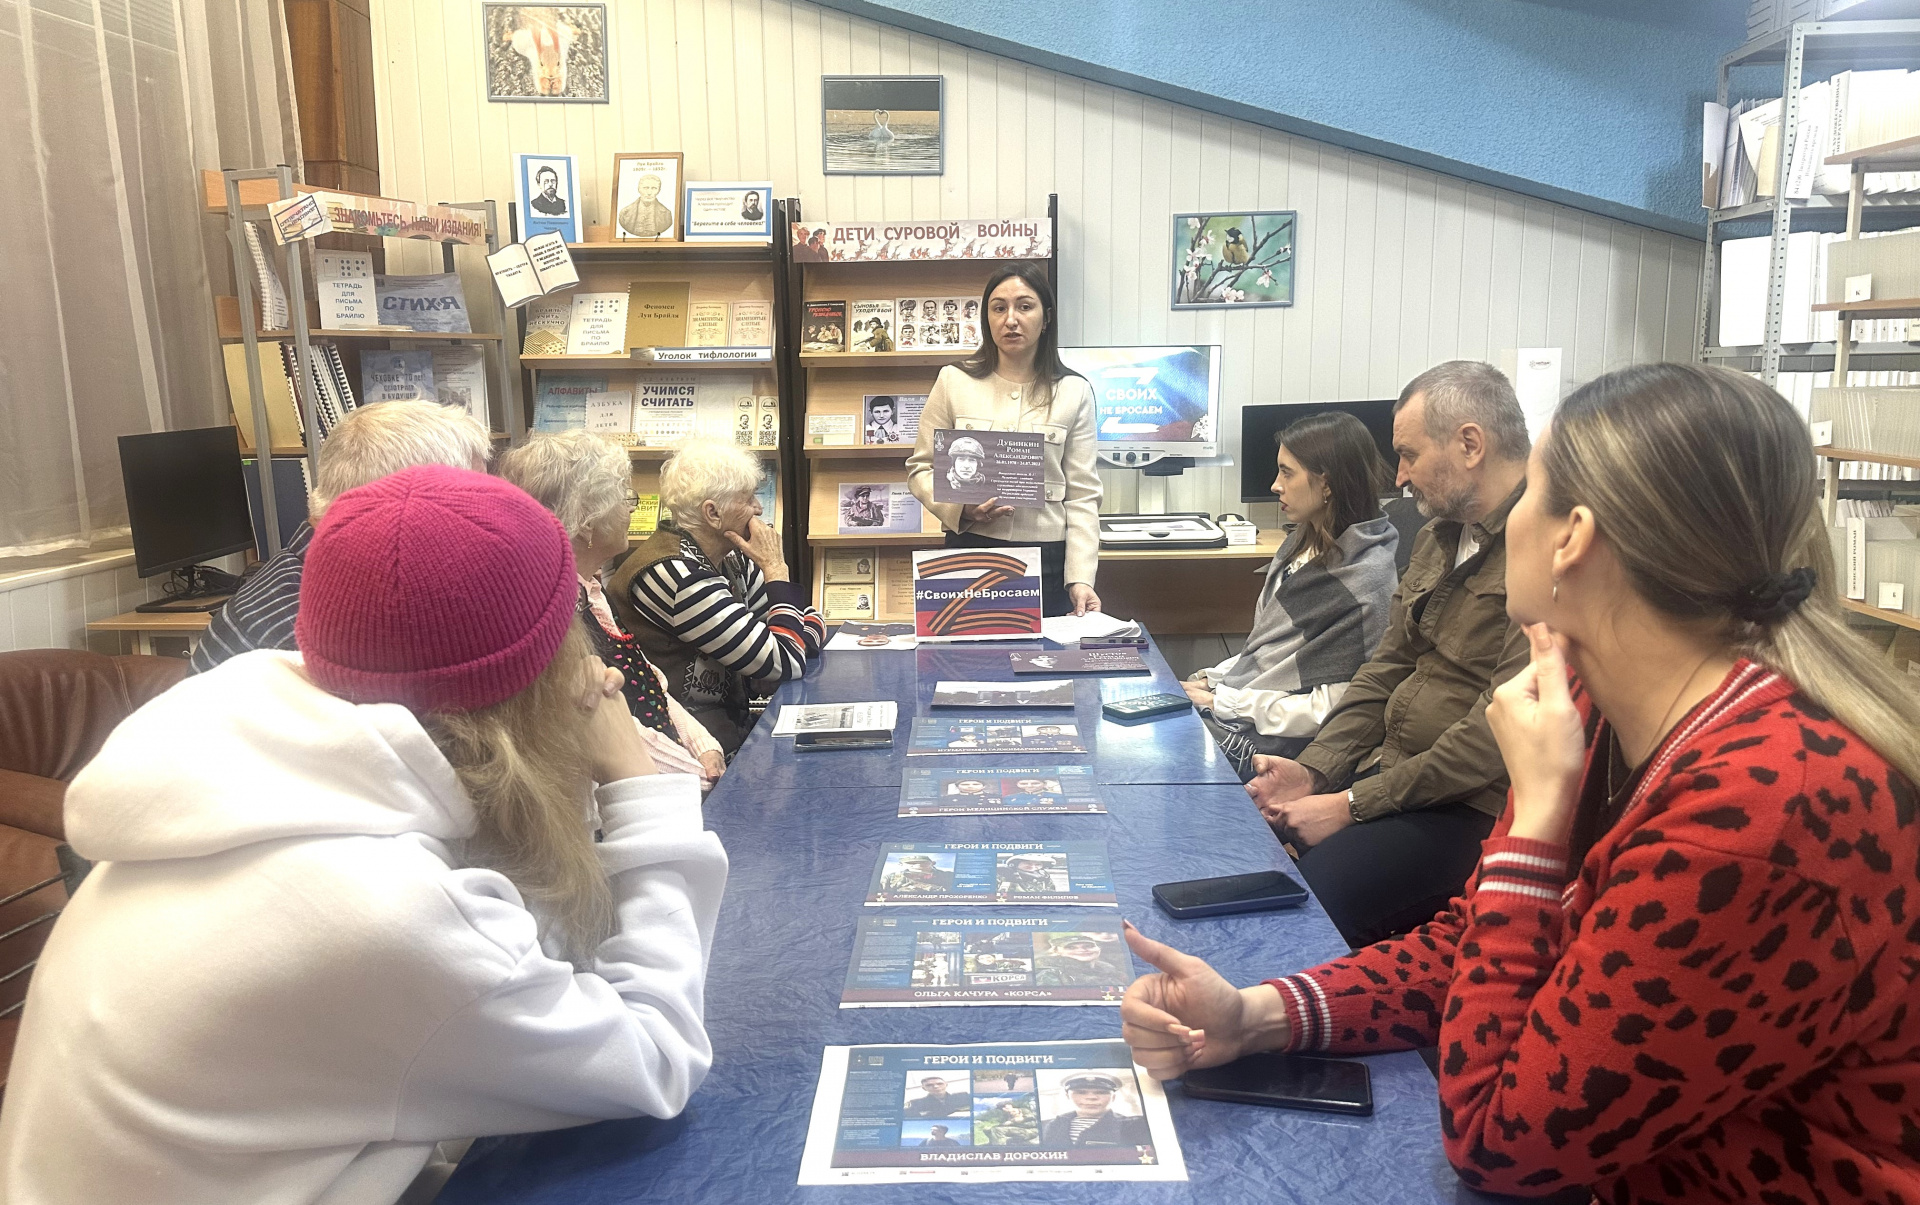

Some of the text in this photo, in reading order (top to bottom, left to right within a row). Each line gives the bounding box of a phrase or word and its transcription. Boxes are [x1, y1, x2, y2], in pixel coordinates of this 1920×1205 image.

[334, 206, 482, 238] ЗНАКОМЬТЕСЬ, НАШИ ИЗДАНИЯ!
[833, 220, 1038, 244] ДЕТИ СУРОВОЙ ВОЙНЫ
[658, 351, 757, 361] Уголок тифлологии
[548, 387, 598, 395] АЛФАВИТЫ
[643, 386, 695, 395] УЧИМСЯ
[1106, 388, 1158, 400] СВОИХ
[641, 398, 694, 407] СЧИТАТЬ
[1115, 406, 1163, 414] БРОСАЕМ
[916, 588, 1040, 600] #СвоихНеБросаем
[988, 918, 1048, 926] ПОДВИГИ
[923, 1054, 1054, 1065] ГЕРОИ И ПОДВИГИ
[920, 1151, 1068, 1162] ВЛАДИСЛАВ ДОРОХИН
